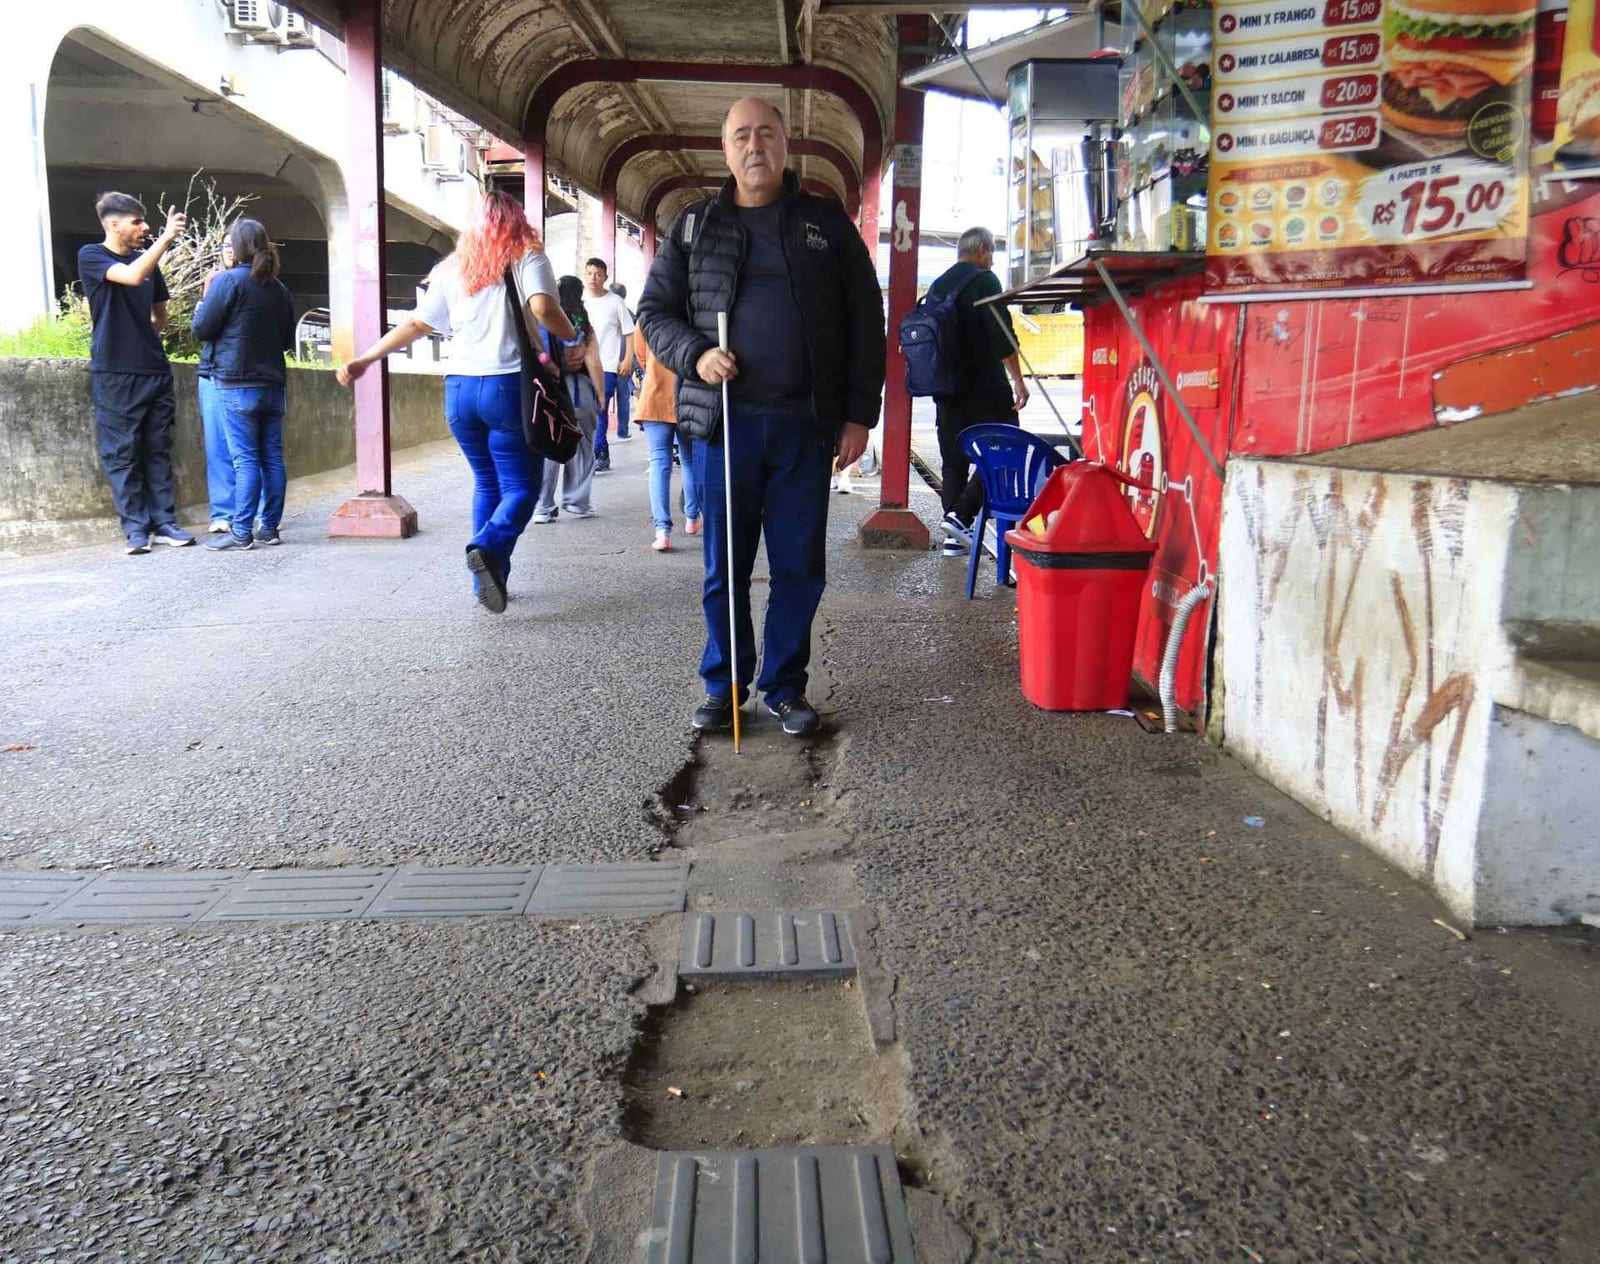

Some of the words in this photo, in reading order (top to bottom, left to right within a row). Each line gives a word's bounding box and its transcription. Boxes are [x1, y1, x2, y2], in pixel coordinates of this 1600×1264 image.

[1239, 15, 1261, 28] MINI
[1264, 14, 1271, 25] X
[1273, 8, 1316, 24] FRANGO
[1238, 56, 1258, 68] MINI
[1260, 54, 1267, 65] X
[1268, 48, 1320, 64] CALABRESA
[1237, 95, 1259, 109] MINI
[1261, 94, 1269, 105] X
[1271, 90, 1305, 105] BACON
[1236, 136, 1259, 149] MINI
[1260, 134, 1267, 145] X
[1268, 129, 1316, 146] BAGUNÇA
[1388, 173, 1396, 183] A
[1397, 166, 1428, 181] PARTIR
[1429, 164, 1442, 175] DE
[1372, 200, 1397, 225] R$
[1400, 175, 1505, 236] 15,00
